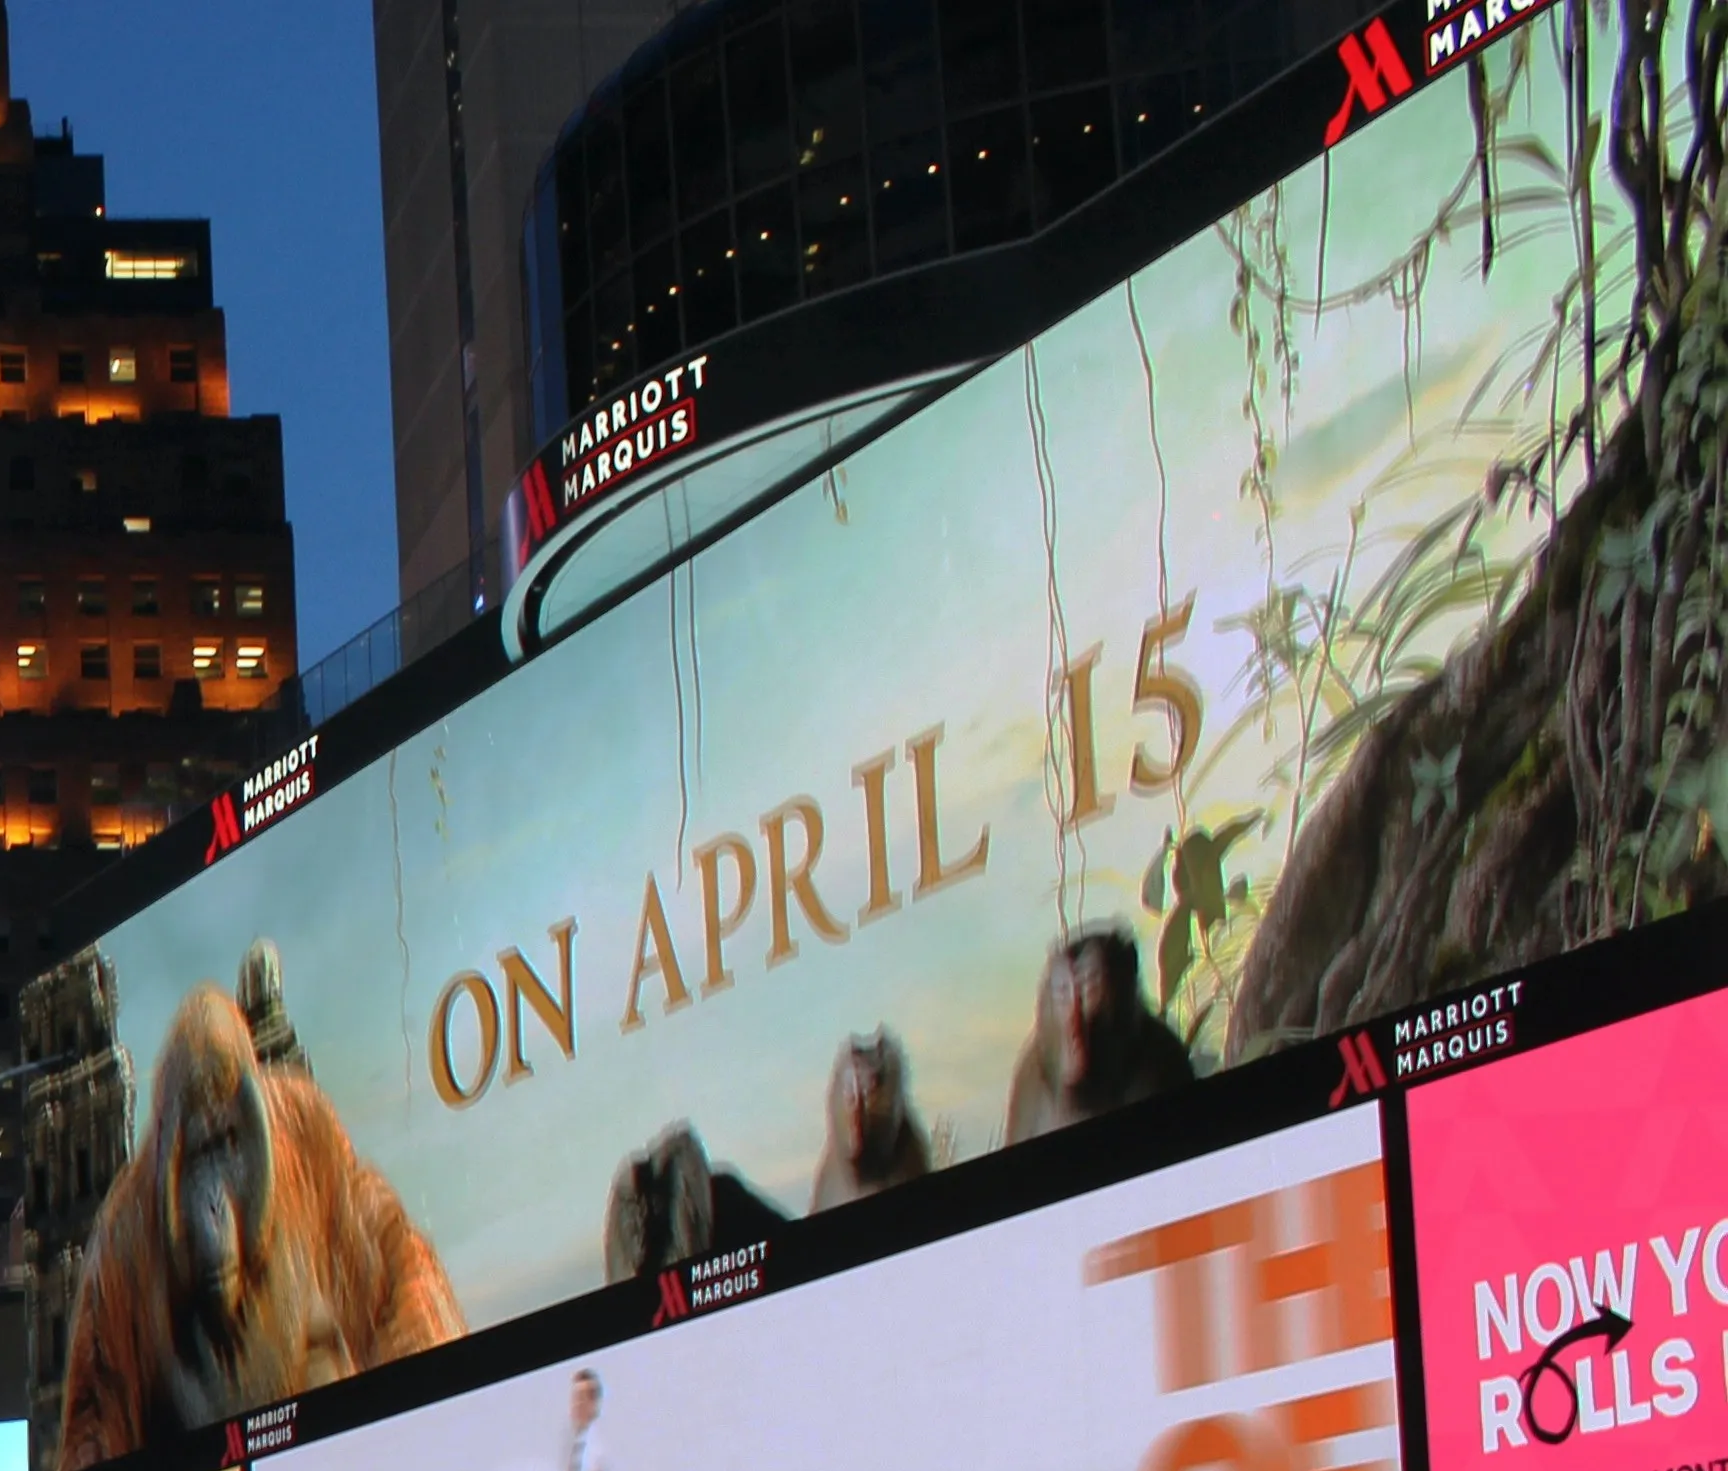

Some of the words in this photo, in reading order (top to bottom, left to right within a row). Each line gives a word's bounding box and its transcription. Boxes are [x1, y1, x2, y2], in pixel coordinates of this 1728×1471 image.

[562, 354, 708, 467] MARRIOTT
[564, 409, 689, 508] MARQUIS
[243, 736, 319, 804] MARRIOTT
[244, 770, 312, 834] MARQUIS
[425, 910, 580, 1113] ON
[618, 722, 989, 1036] APRIL
[1060, 590, 1204, 829] 15
[1395, 981, 1522, 1044] MARRIOTT
[1398, 1018, 1510, 1076] MARQUIS
[690, 1242, 768, 1283] MARRIOTT
[692, 1270, 760, 1309] MARQUIS
[1474, 1243, 1638, 1360] NOW
[247, 1403, 298, 1431] MARRIOTT
[1479, 1338, 1698, 1454] ROLLS
[247, 1427, 293, 1452] MARQUIS
